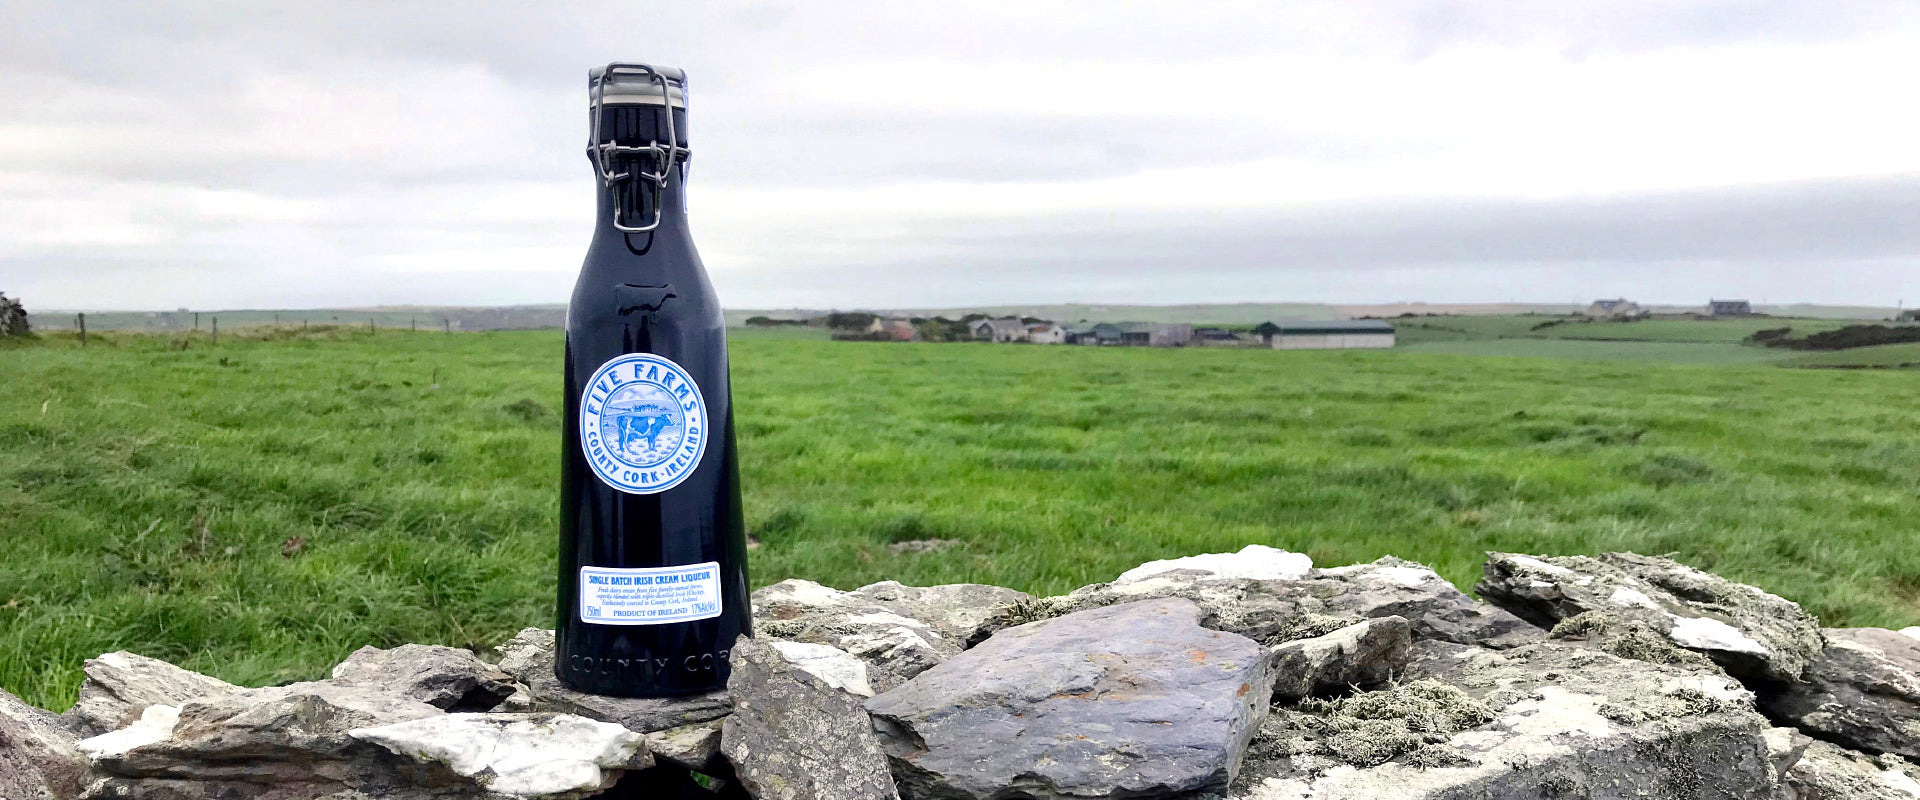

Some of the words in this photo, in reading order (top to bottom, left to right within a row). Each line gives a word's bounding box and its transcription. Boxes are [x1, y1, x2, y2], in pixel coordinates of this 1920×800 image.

[587, 370, 622, 416] FIVE
[634, 363, 697, 413] FARMS
[588, 431, 620, 475] COUNTY
[623, 470, 661, 484] CORK
[664, 426, 699, 477] IRELAND
[588, 575, 609, 585] SINGLE
[611, 576, 632, 586] BATCH
[634, 576, 653, 586] IRISH
[655, 574, 679, 585] CREAM
[681, 571, 711, 583] LIQUEUR
[586, 605, 602, 617] 750ml
[658, 607, 688, 616] IRELAND
[571, 653, 669, 676] COUNTY
